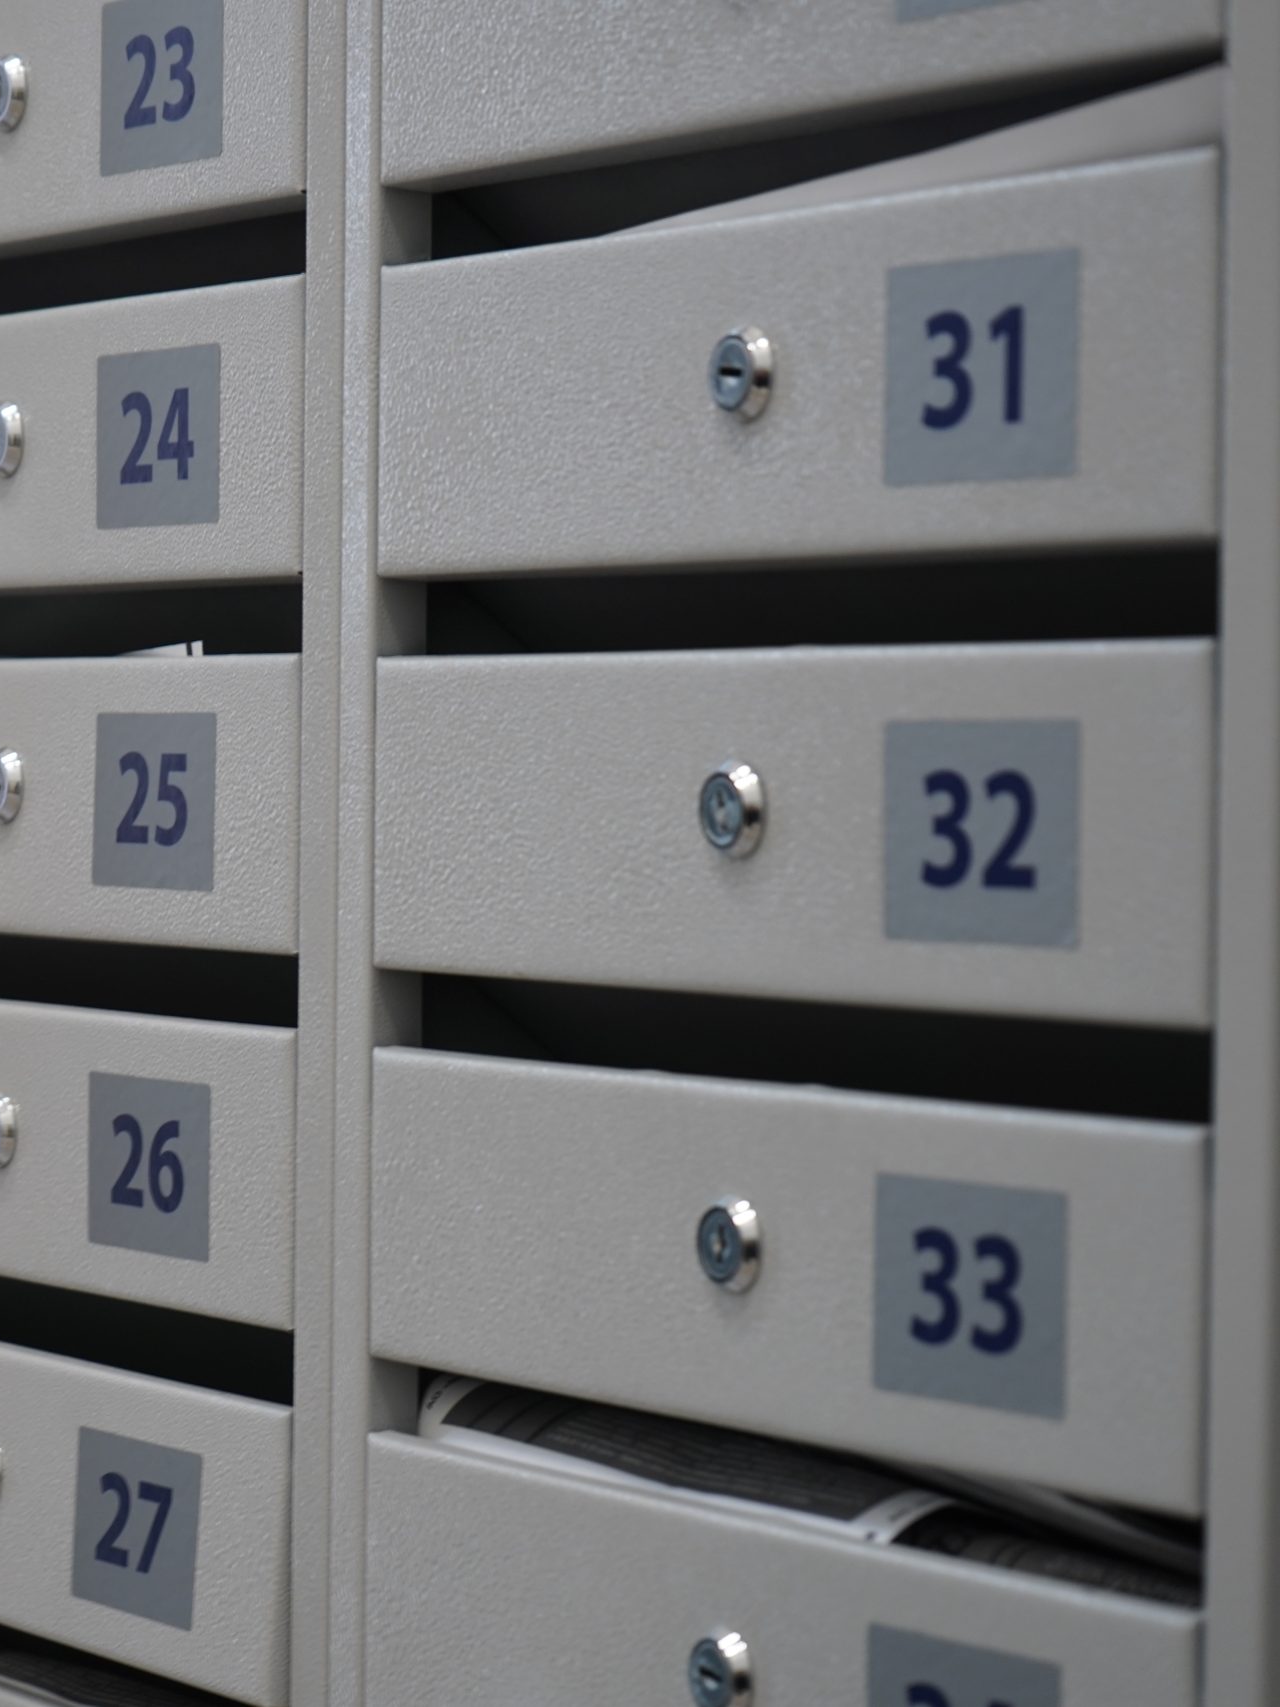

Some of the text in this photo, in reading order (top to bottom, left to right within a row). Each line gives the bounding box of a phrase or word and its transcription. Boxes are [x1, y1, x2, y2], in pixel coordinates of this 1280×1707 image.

[124, 26, 195, 129] 23
[923, 306, 1023, 429] 31
[120, 388, 194, 484] 24
[116, 752, 187, 846] 25
[922, 771, 1035, 889] 32
[111, 1114, 184, 1213] 26
[911, 1228, 1022, 1354] 33
[95, 1473, 172, 1573] 27
